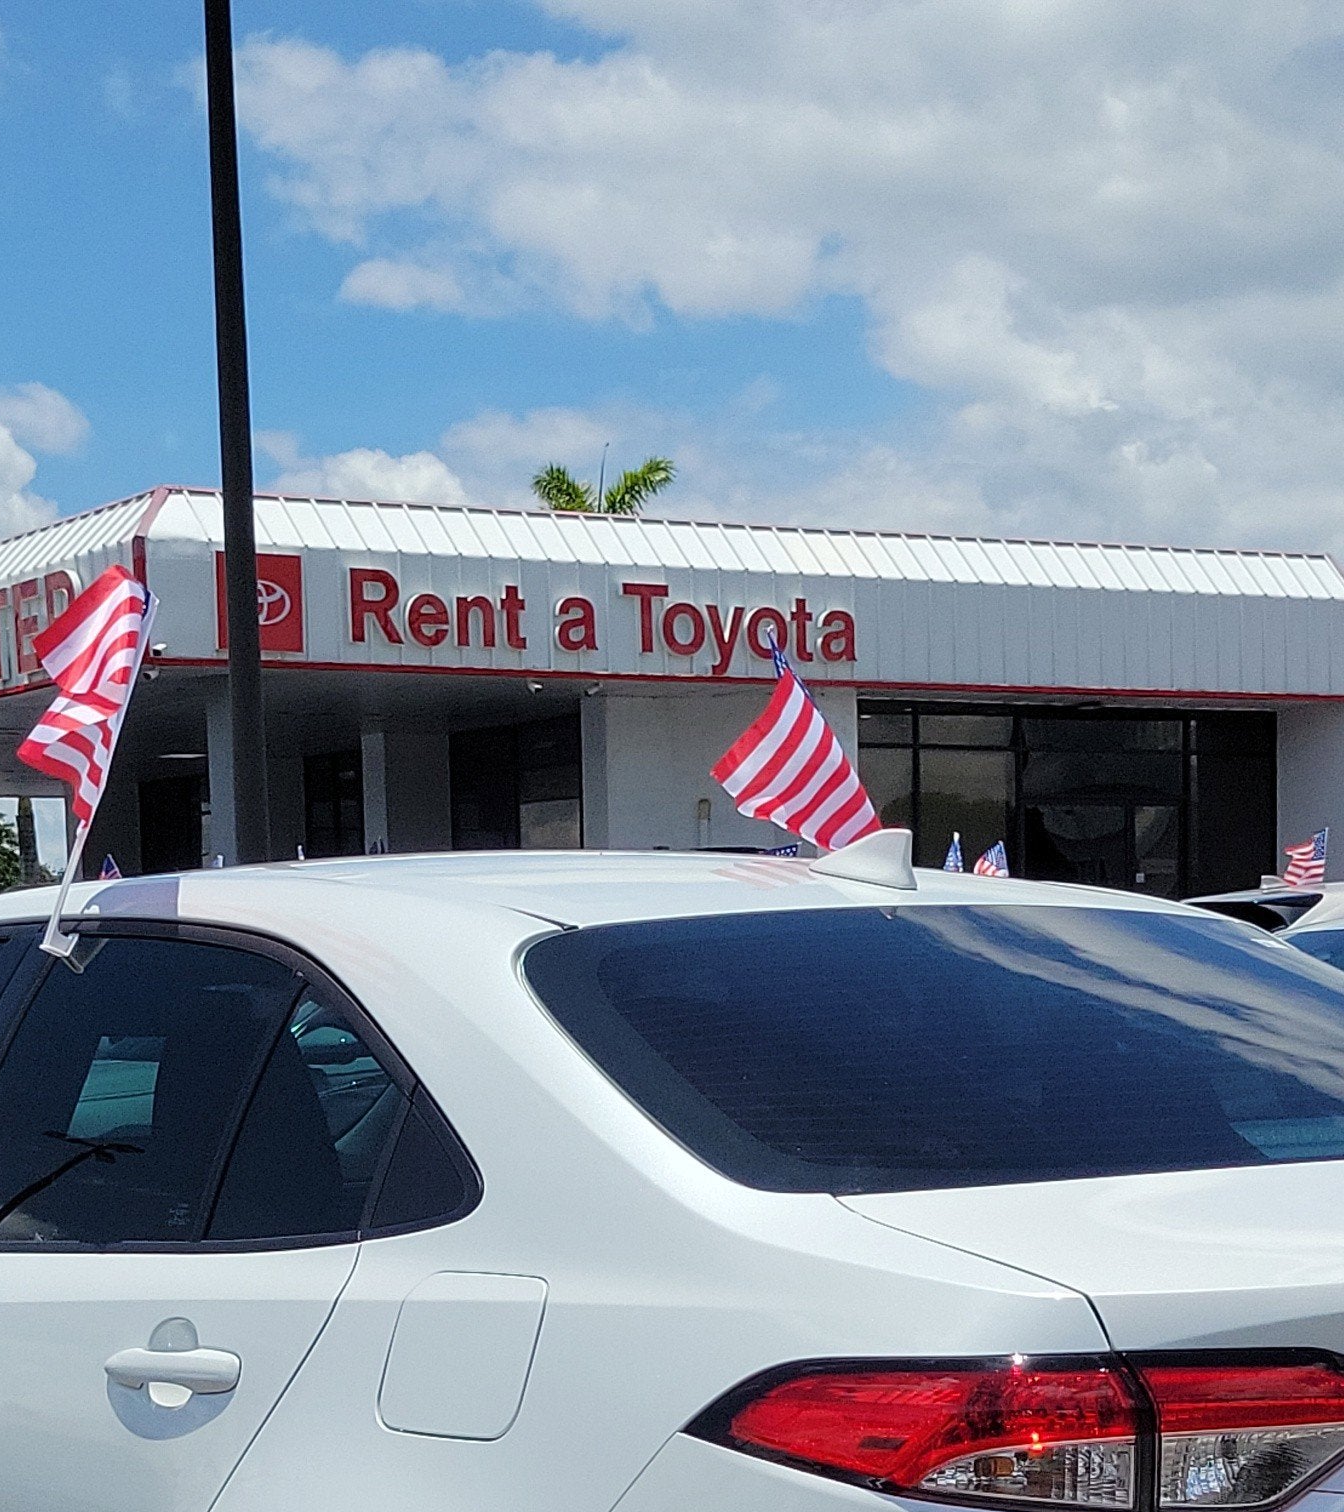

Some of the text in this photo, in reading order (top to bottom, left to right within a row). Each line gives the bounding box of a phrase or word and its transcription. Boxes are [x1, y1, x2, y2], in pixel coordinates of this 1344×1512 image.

[348, 567, 857, 675] Rent a Toyota
